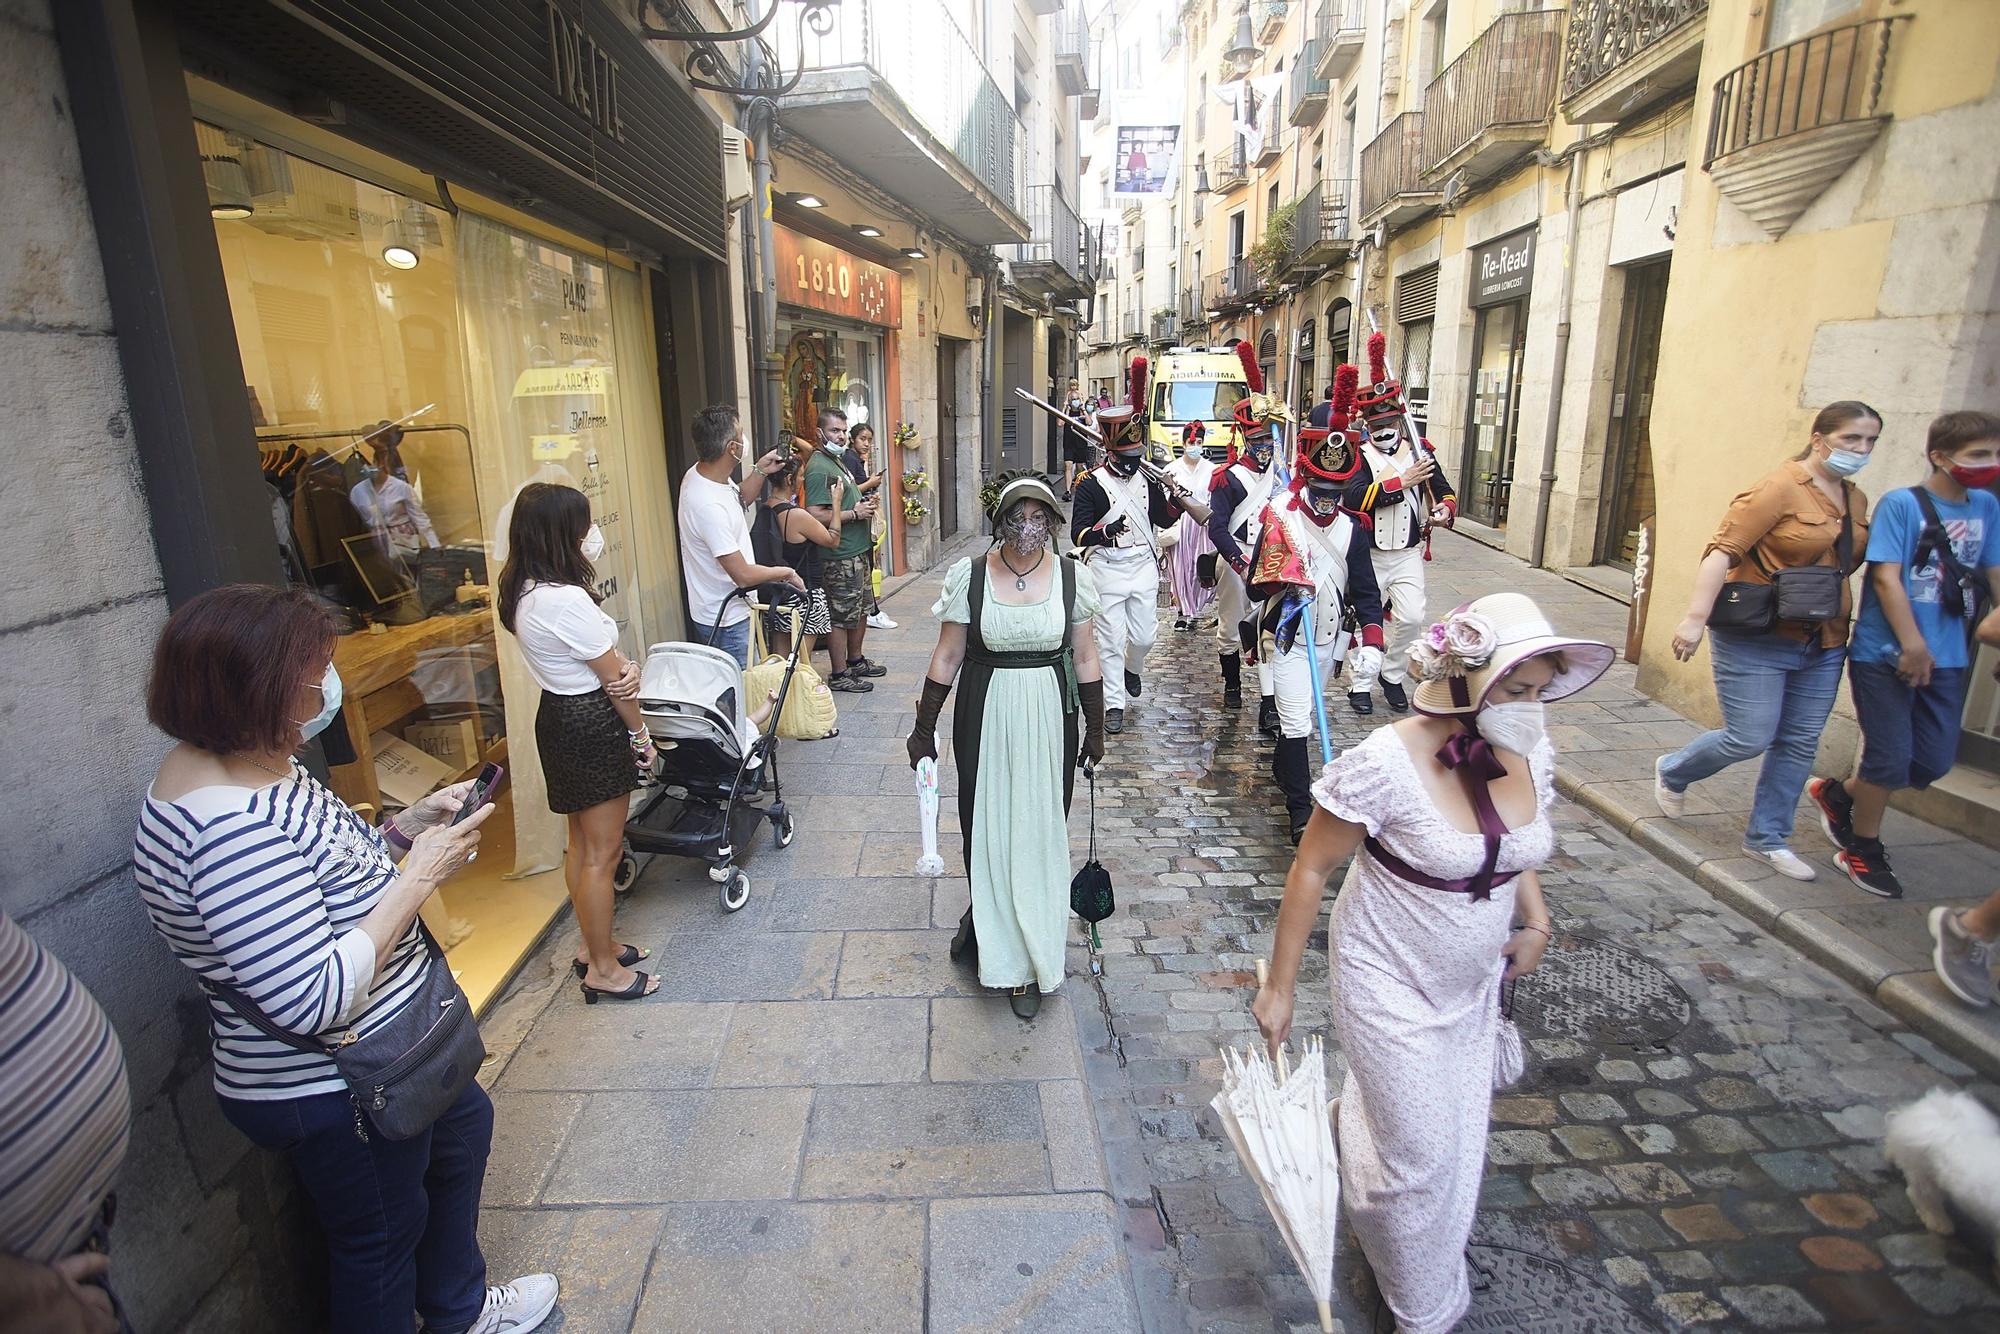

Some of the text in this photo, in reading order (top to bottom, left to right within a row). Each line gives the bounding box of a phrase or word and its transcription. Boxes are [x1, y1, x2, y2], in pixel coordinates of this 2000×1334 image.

[796, 254, 850, 298] 1810
[1482, 237, 1530, 280] Re-Read
[562, 279, 587, 313] P448
